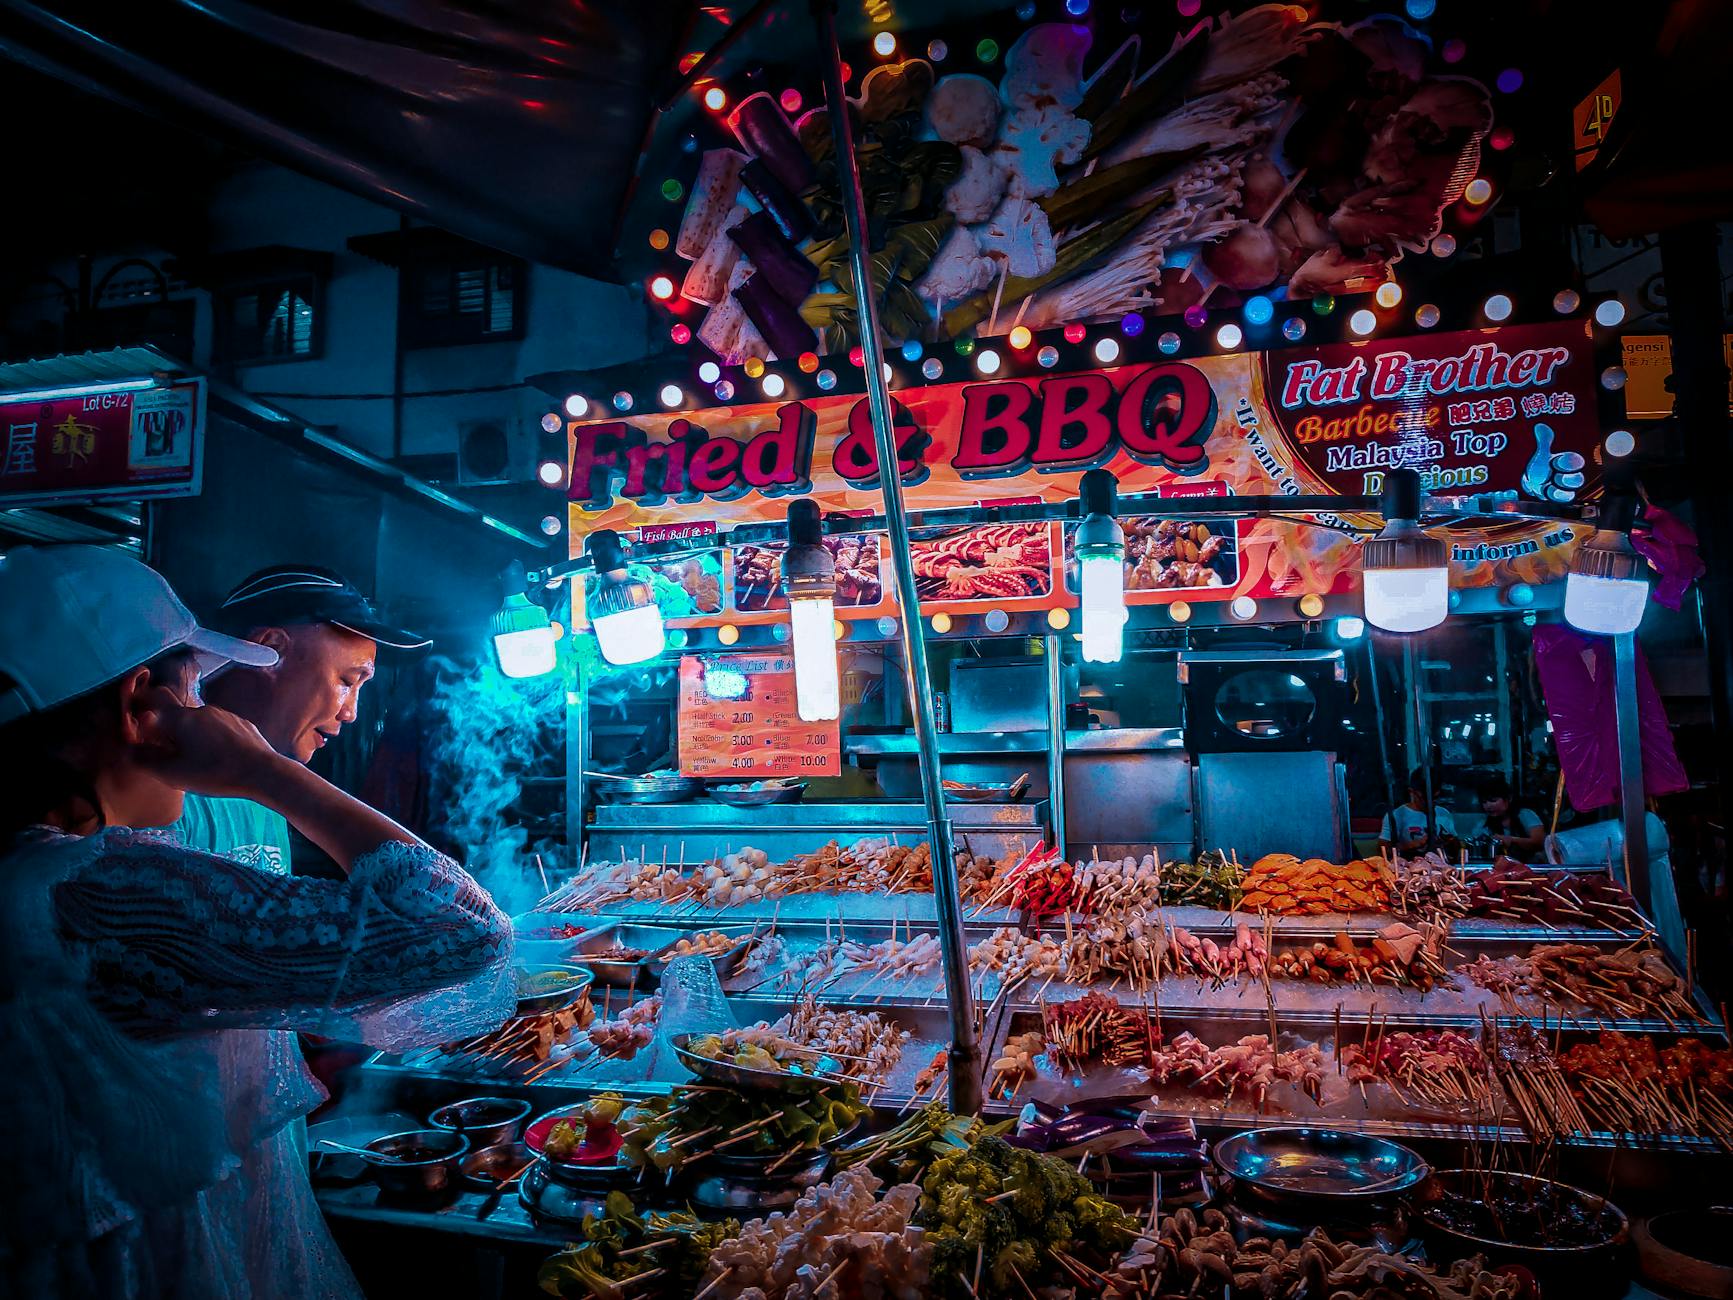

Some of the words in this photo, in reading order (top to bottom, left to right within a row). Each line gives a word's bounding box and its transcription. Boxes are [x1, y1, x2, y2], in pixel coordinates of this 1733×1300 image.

[1583, 94, 1613, 140] 4D
[1281, 356, 1368, 409] Fat
[1370, 343, 1569, 400] Brother
[83, 396, 100, 412] Lot
[102, 391, 129, 410] G-72
[569, 402, 812, 498] Fried
[832, 394, 926, 485] &
[952, 362, 1216, 473] BBQ
[1295, 404, 1440, 444] Barbece
[1246, 428, 1286, 480] want
[1279, 477, 1300, 496] to
[1327, 439, 1443, 473] Malaysia
[1450, 430, 1508, 458] Top
[1363, 464, 1489, 497] Dcious
[644, 528, 666, 542] Fish
[668, 527, 690, 540] Ball
[1451, 538, 1540, 562] inform
[1544, 527, 1575, 550] us
[732, 712, 754, 724] 2.00
[732, 734, 754, 746] 3.00
[806, 734, 827, 746] 7.00
[732, 757, 754, 769] 4.00
[800, 755, 827, 767] 10.00
